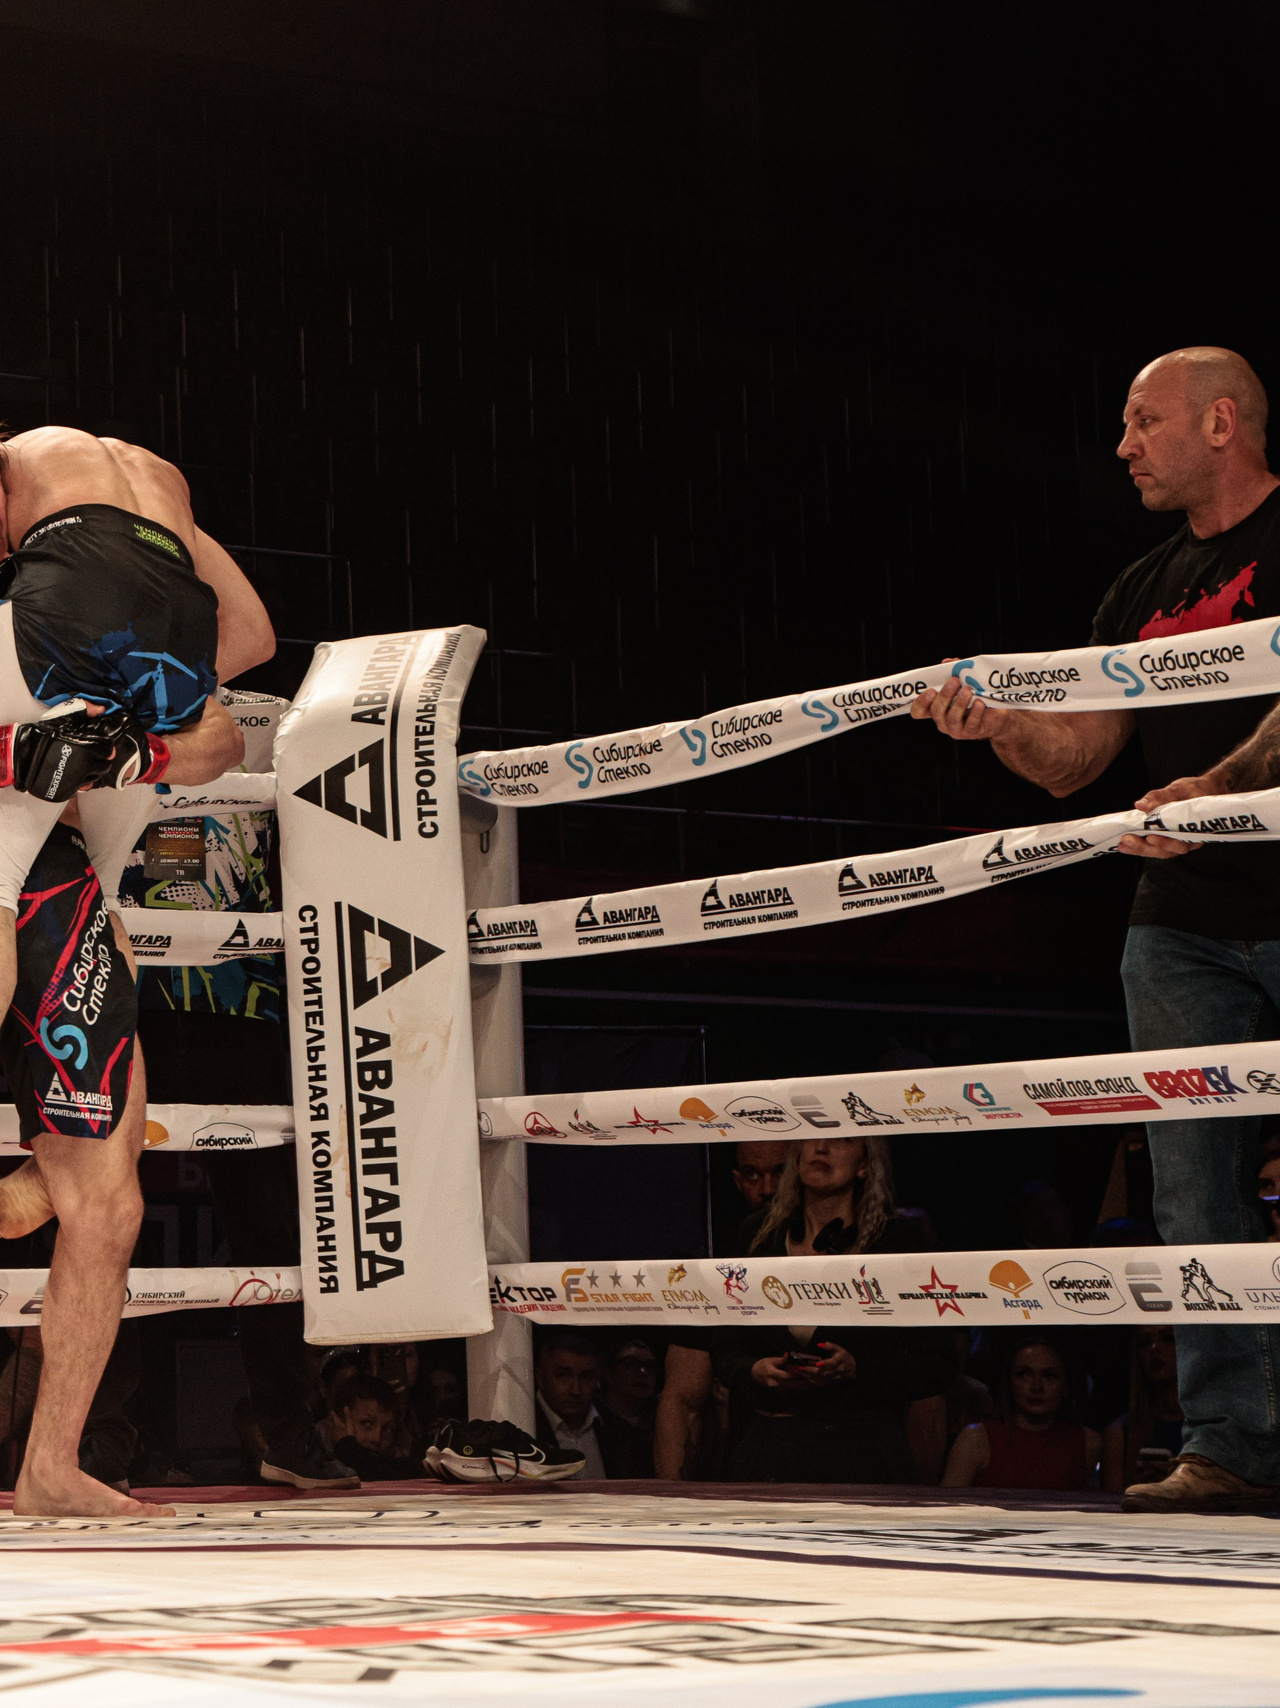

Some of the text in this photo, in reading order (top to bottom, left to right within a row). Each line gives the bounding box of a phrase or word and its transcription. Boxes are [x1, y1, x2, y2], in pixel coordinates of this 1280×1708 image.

[1139, 644, 1245, 674] Сибирское
[351, 634, 421, 726] АВАНГАРД
[988, 667, 1082, 689] Сибирское
[1150, 670, 1230, 691] Стекло
[833, 681, 928, 708] Сибирское
[711, 708, 783, 739] Сибирское
[593, 739, 664, 764] Сибирское
[711, 732, 772, 758] Стекло
[414, 680, 442, 839] СТРОИТЕЛЬНАЯ
[484, 760, 549, 782] Сибирское
[597, 762, 651, 783] Стекло
[490, 782, 539, 797] Стекло
[1178, 814, 1269, 834] АВАНГАРД
[1014, 837, 1094, 862] АВАНГАРД
[868, 865, 939, 888] АВАНГАРД
[728, 887, 795, 908] АВАНГАРД
[842, 886, 945, 911] СТРОИТЕЛЬНАЯ КОМПАНИЯ
[602, 905, 661, 925] АВАНГАРД
[703, 909, 798, 930] СТРОИТЕЛЬНАЯ КОМПАНИЯ
[486, 920, 538, 937] АВАНГАРД
[578, 928, 664, 945] СТРОИТЕЛЬНАЯ КОМПАНИЯ
[129, 934, 172, 947] НГАРД
[82, 944, 112, 1026] Стекло
[1023, 1076, 1143, 1100] САМОЙЛОВ ФОНД
[1143, 1066, 1249, 1099] BROZEX
[298, 904, 339, 1294] СТРОИТЕЛЬНАЯ КОМПАНИЯ
[195, 1133, 254, 1147] сибирский
[354, 1025, 405, 1289] АВАНГАРД
[254, 1283, 305, 1301] Отел
[489, 1276, 558, 1302] ЕКТОР
[788, 1279, 853, 1300] ТЁРКИ
[1049, 1274, 1113, 1291] сибирский
[136, 1290, 186, 1299] СИБИРСКИЙ
[590, 1293, 655, 1303] STAR FIGHT
[1002, 1297, 1043, 1310] Асгард
[1064, 1291, 1110, 1304] гурман
[1183, 1302, 1243, 1311] BOXING HALL
